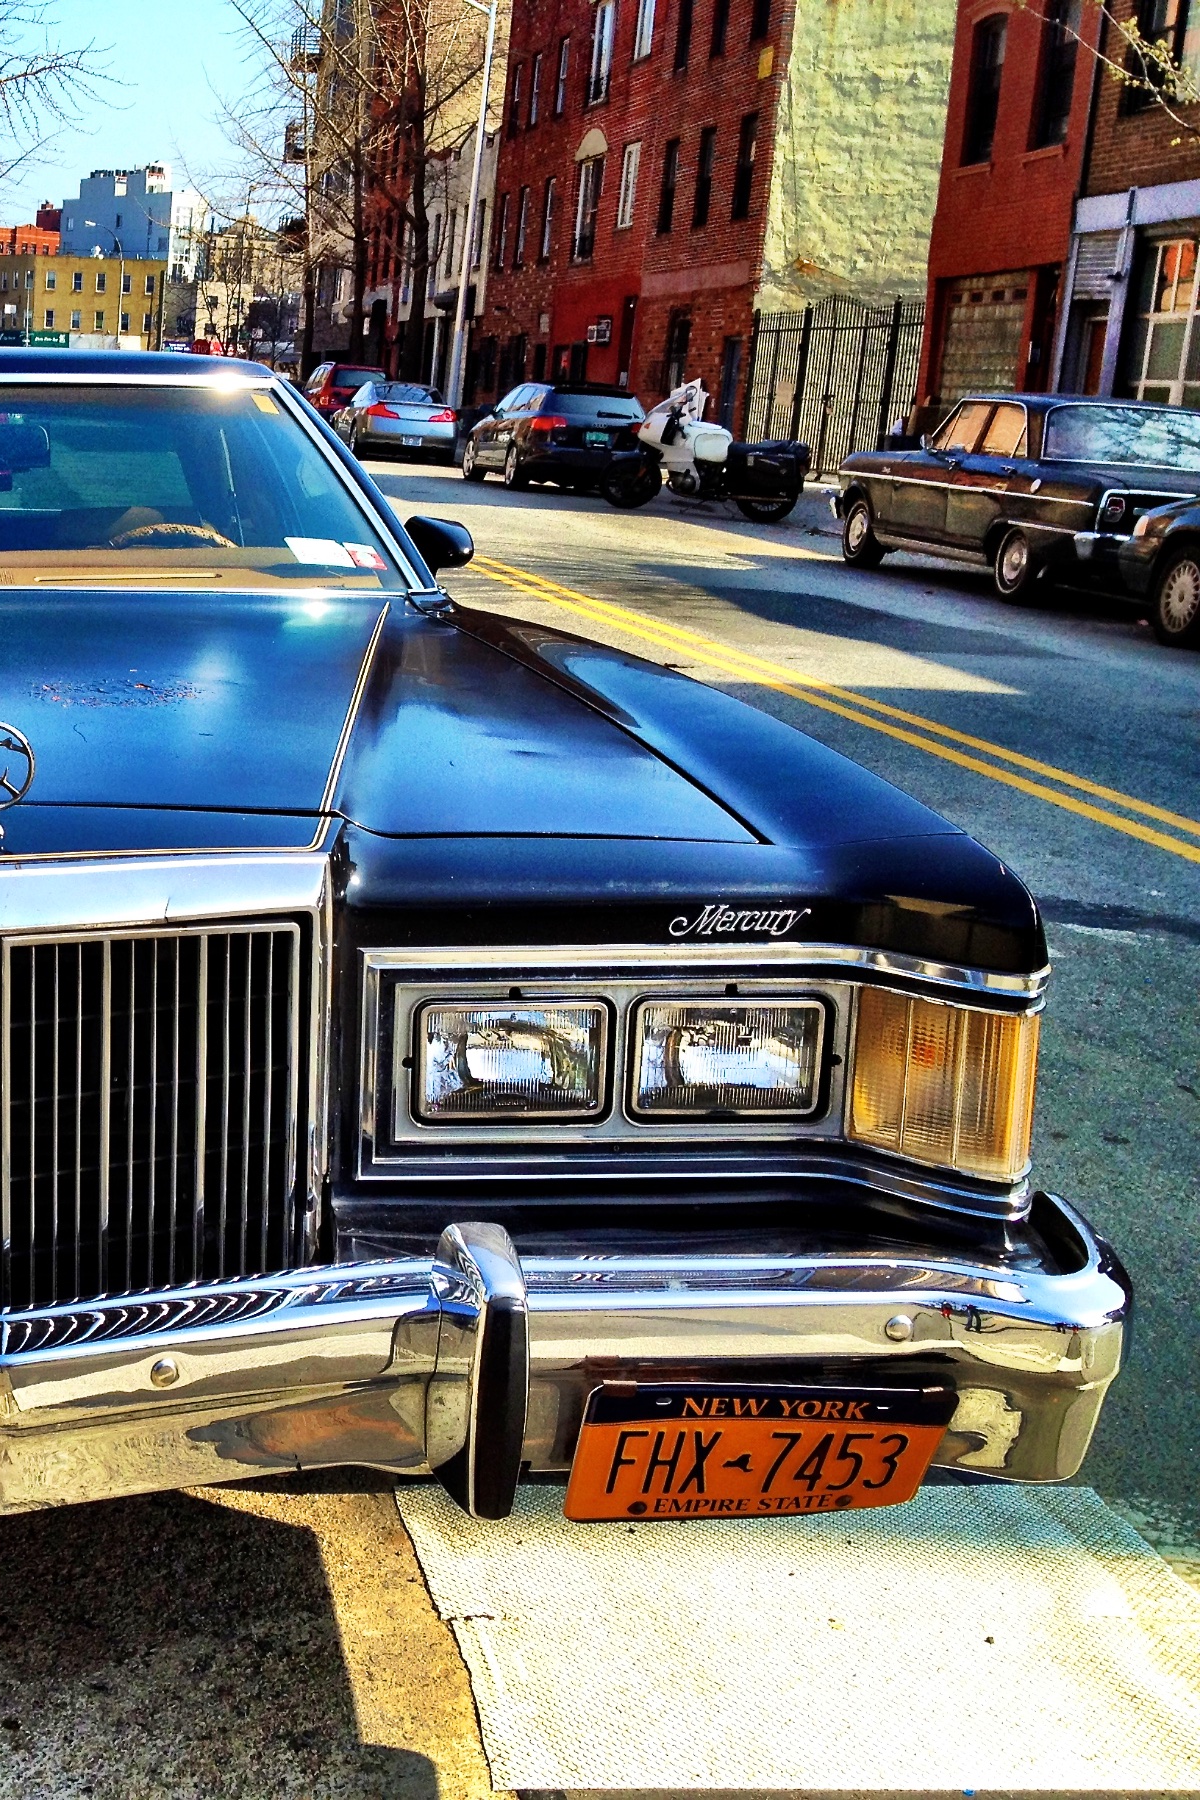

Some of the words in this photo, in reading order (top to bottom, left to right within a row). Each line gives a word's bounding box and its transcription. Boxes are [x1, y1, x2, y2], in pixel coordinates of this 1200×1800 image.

[668, 904, 812, 936] Mercury
[681, 1397, 769, 1417] NEW
[779, 1399, 871, 1420] YORK
[605, 1430, 722, 1495] FHX
[760, 1431, 911, 1494] 7453
[652, 1497, 751, 1514] EMPIRE
[756, 1493, 834, 1511] STATE
